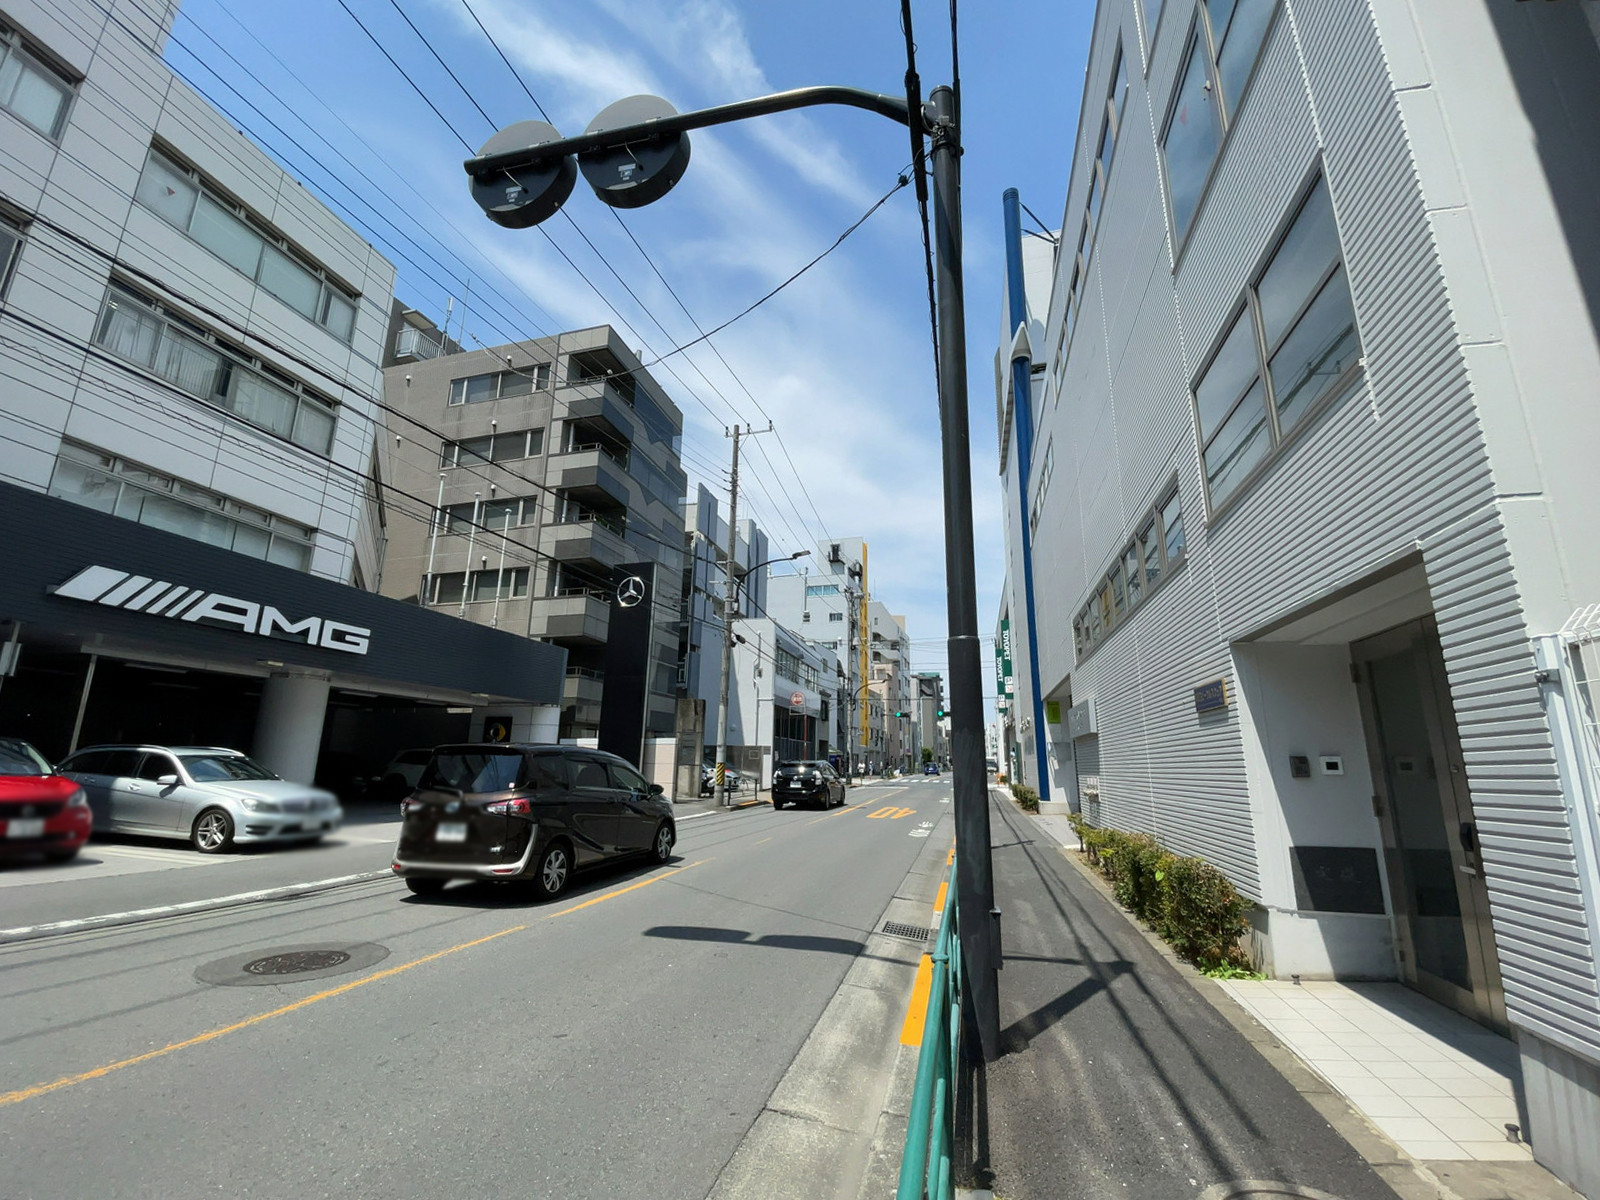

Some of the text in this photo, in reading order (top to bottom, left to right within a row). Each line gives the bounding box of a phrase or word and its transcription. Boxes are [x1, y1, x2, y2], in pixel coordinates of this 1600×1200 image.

[181, 593, 371, 655] AMG
[1003, 630, 1011, 660] TOYOPET
[866, 806, 917, 819] 40
